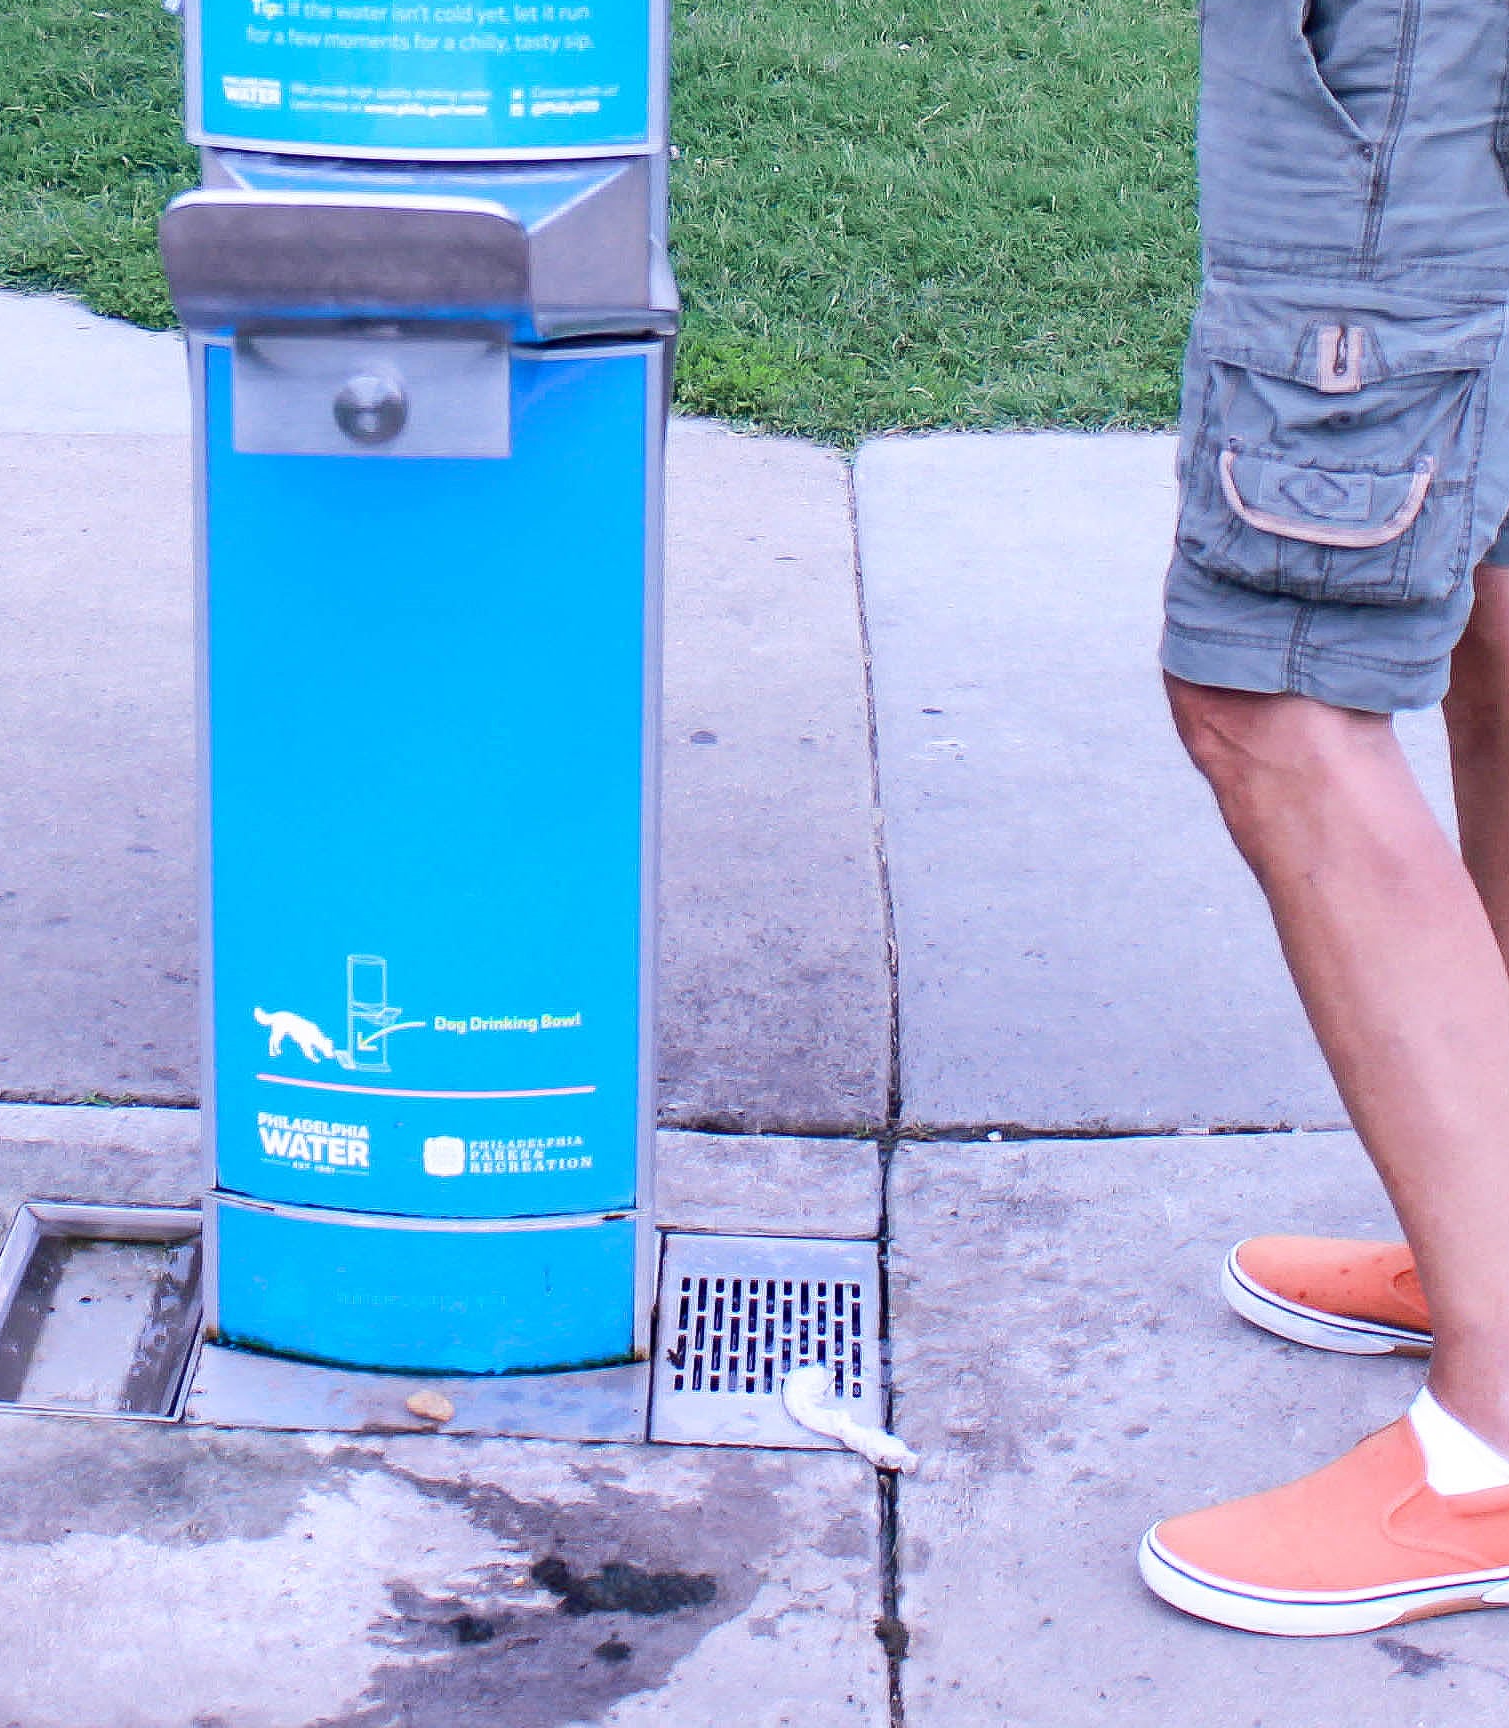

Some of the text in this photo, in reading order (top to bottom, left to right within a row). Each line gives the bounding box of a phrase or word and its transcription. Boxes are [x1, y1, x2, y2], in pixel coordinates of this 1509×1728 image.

[304, 1, 333, 18] the
[337, 4, 389, 20] water
[434, 4, 473, 23] cold
[513, 2, 538, 22] let
[543, 4, 555, 21] it
[558, 6, 592, 21] run
[246, 23, 271, 43] for
[273, 30, 285, 45] a
[288, 27, 321, 47] few
[324, 31, 411, 50] moments
[414, 31, 440, 49] for
[442, 36, 455, 49] a
[514, 33, 560, 53] tasty
[433, 1010, 582, 1035] Dog Drinking Bowl
[258, 1111, 370, 1139] PHILADELPHIA
[259, 1127, 370, 1169] WATER
[469, 1135, 584, 1153] PHILADELPHIA
[469, 1155, 594, 1175] RECREATION
